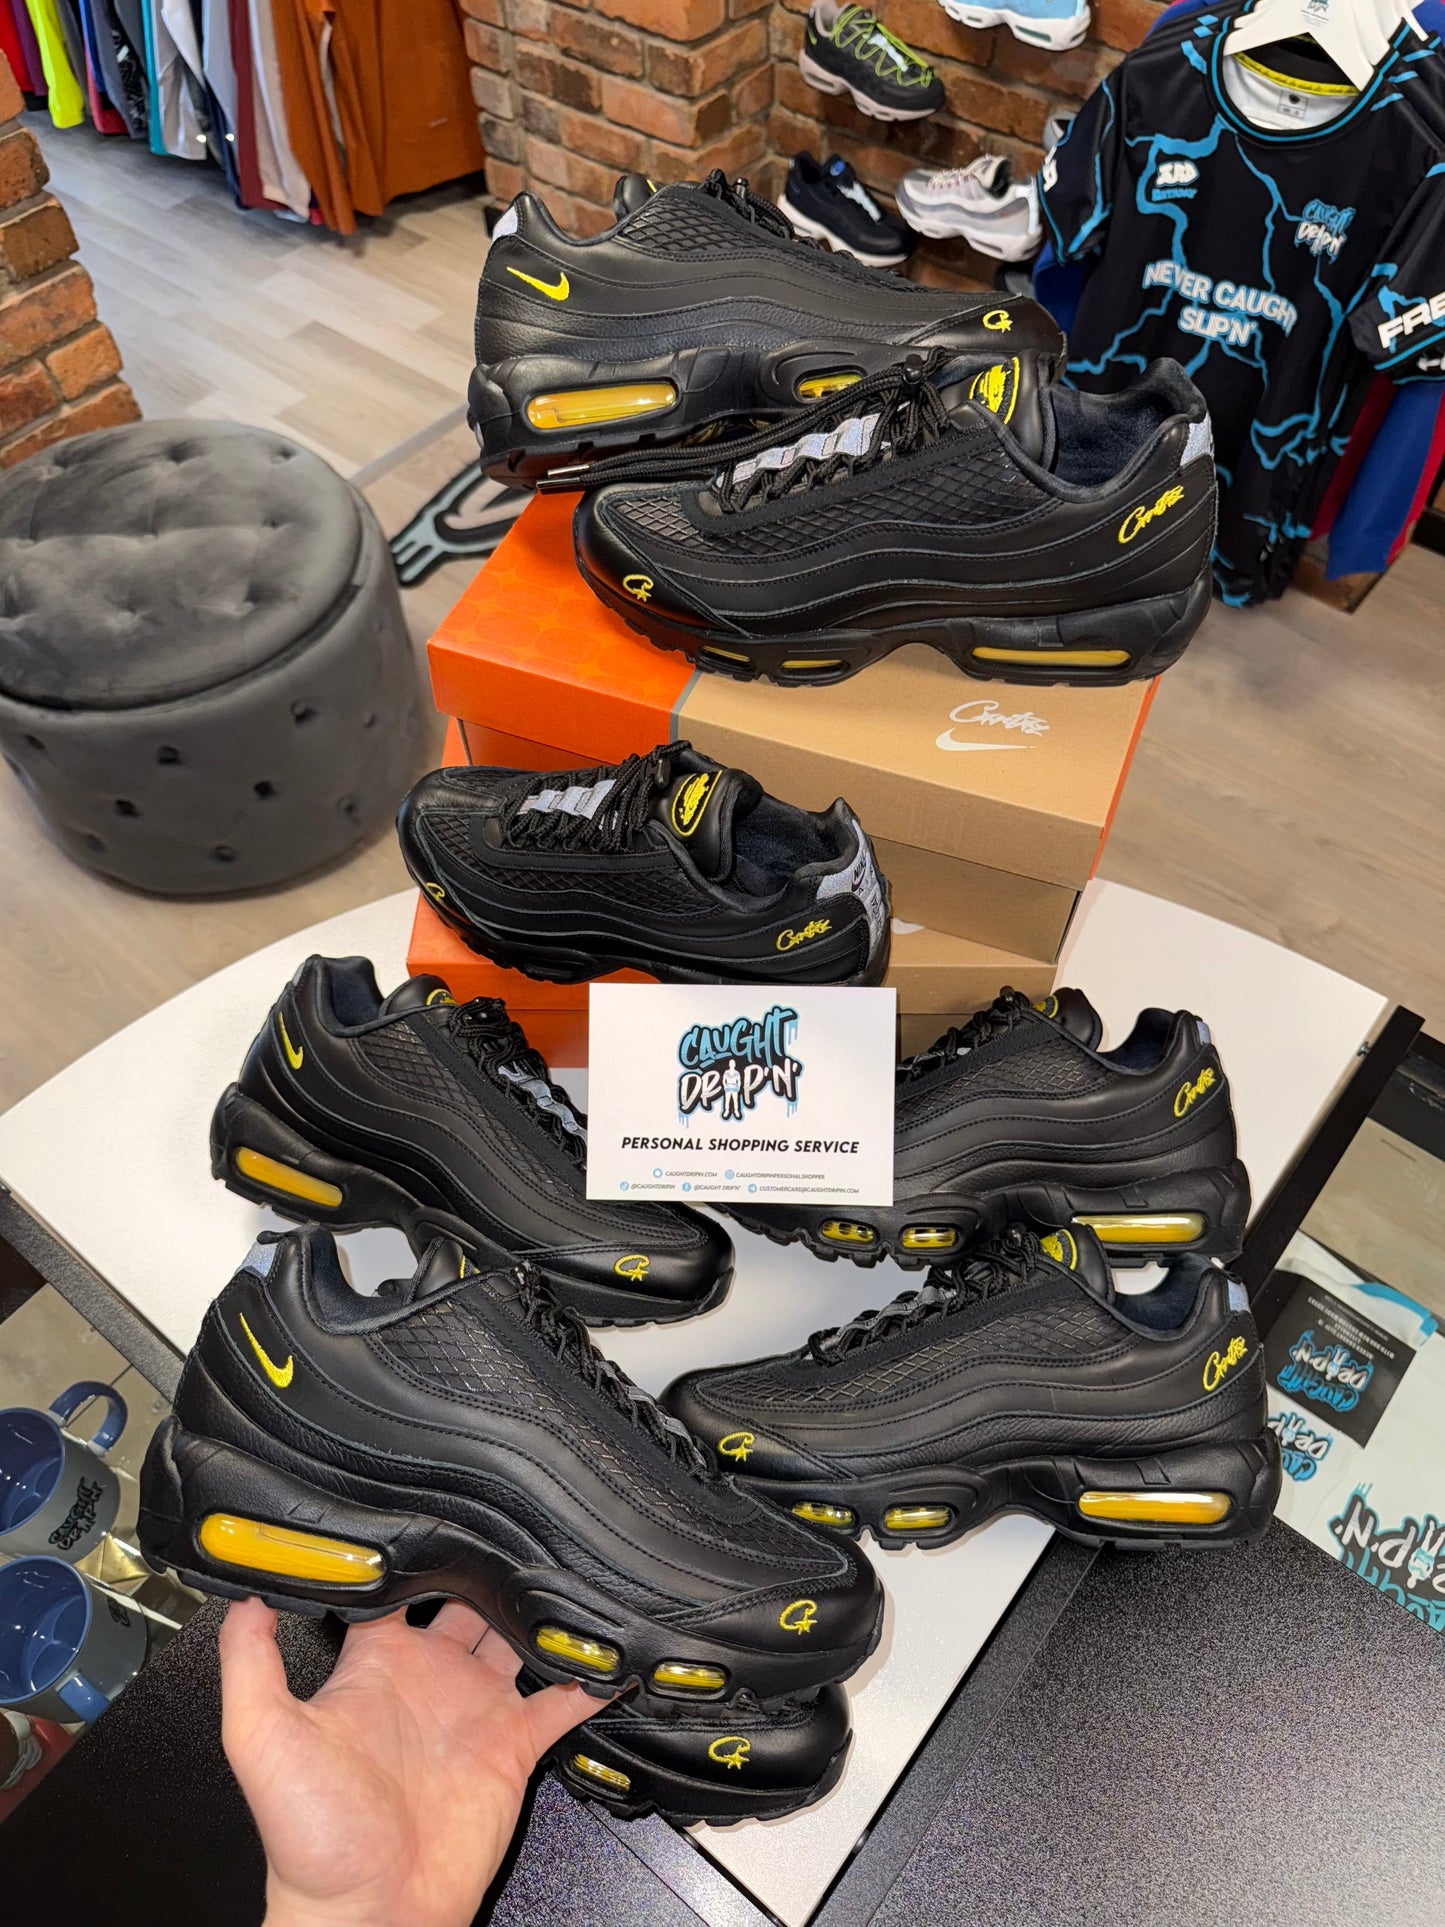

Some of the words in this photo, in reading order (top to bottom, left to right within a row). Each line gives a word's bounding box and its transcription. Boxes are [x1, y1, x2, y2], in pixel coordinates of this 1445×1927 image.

[1142, 259, 1212, 304] NEVER
[1213, 280, 1298, 337] CAUGHT
[678, 1005, 799, 1070] CAUGHT
[621, 1136, 704, 1151] PERSONAL
[708, 1138, 790, 1153] SHOPPING
[794, 1139, 860, 1154] SERVICE
[665, 1170, 718, 1178] CAUGHTDRIPIN.COM
[735, 1172, 826, 1180] CAUGHTDRIPINPERSONALSHOPPER
[759, 1185, 860, 1194] CUSTOMERCARE@CAUGHTDRIPIN.COM
[1277, 1364, 1359, 1411] CAUGHT
